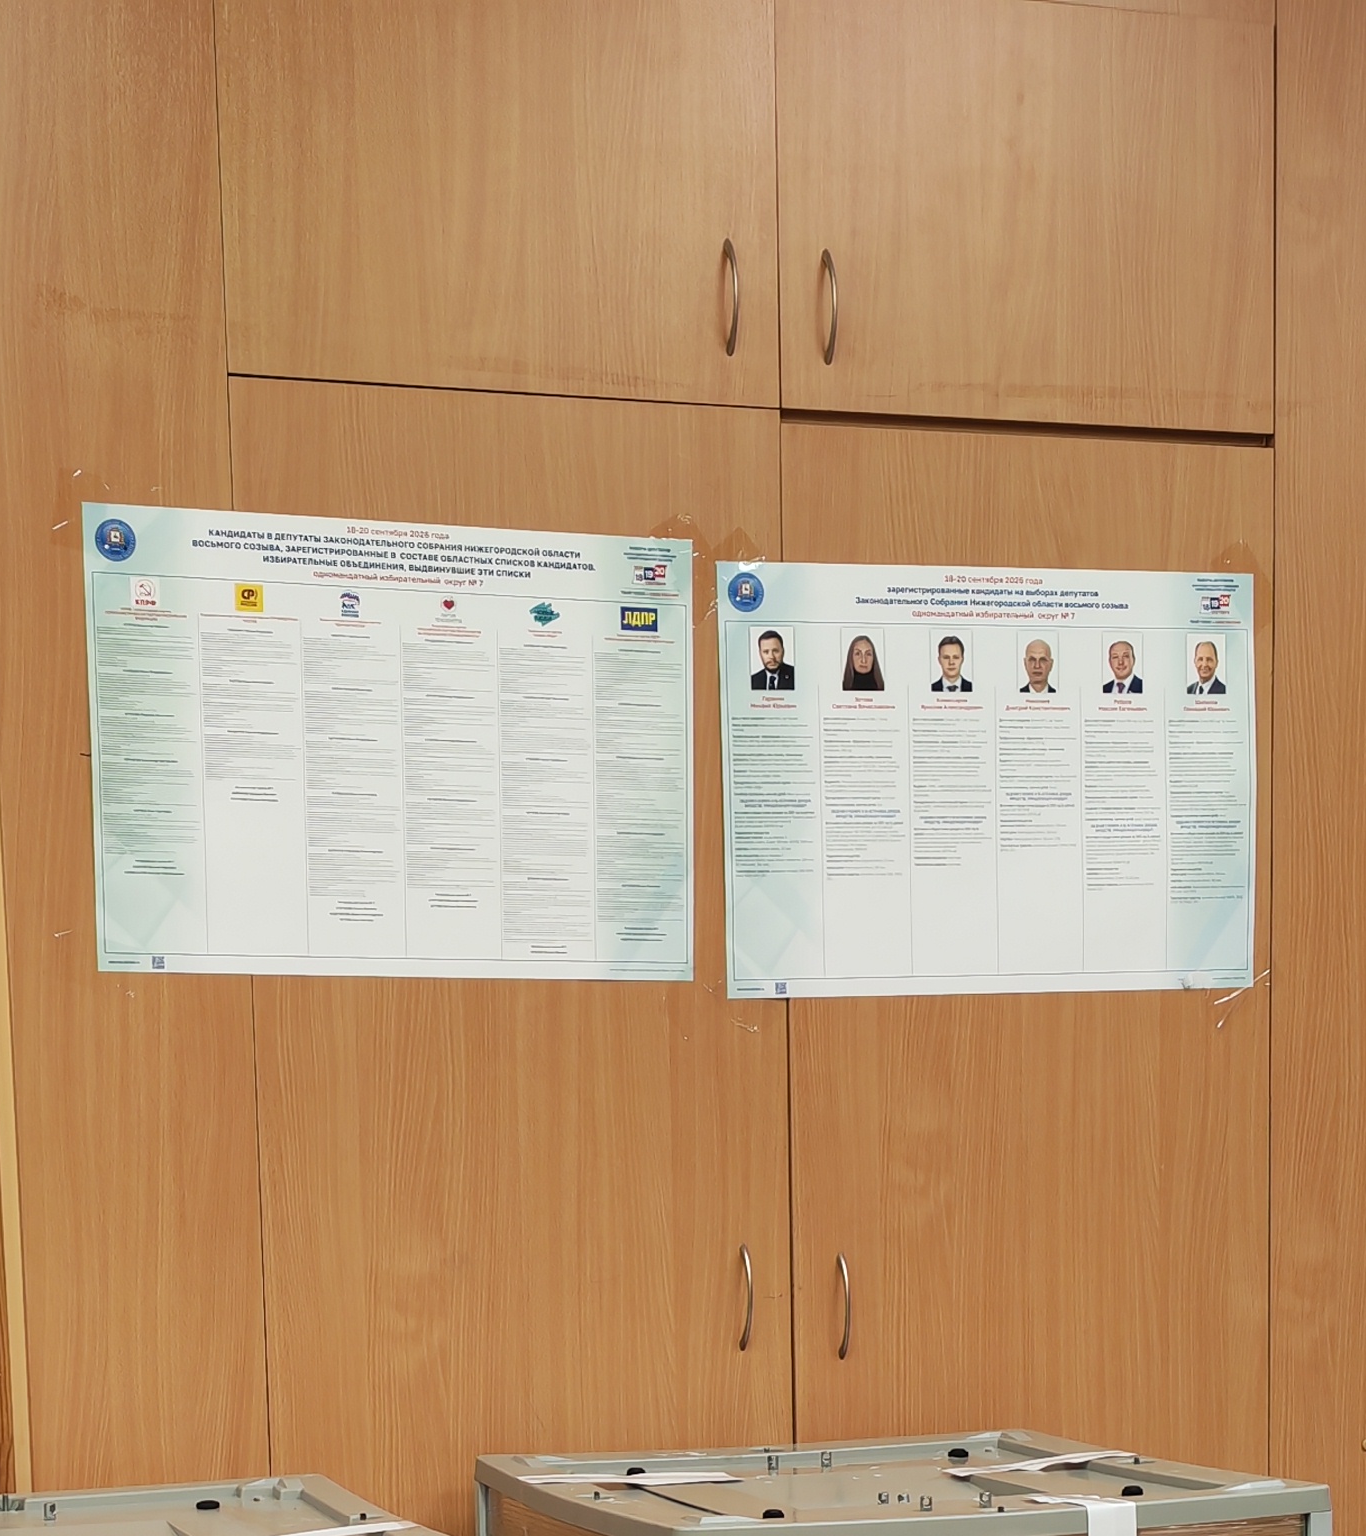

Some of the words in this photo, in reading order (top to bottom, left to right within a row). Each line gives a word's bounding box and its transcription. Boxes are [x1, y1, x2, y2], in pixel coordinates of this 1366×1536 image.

[208, 529, 265, 540] КАНДИДАТЫ
[267, 532, 273, 540] В
[274, 533, 321, 543] ДЕПУТАТЫ
[323, 536, 415, 549] ЗАКОНОДАТЕЛЬНОГО
[417, 542, 463, 552] СОБРАНИЯ
[464, 544, 540, 557] НИЖЕГОРОДСКОЙ
[542, 550, 581, 559] ОБЛАСТИ
[192, 540, 242, 550] ВОСЬМОГО
[243, 543, 284, 553] СОЗЫВА,
[285, 545, 388, 559] ЗАРЕГИСТРИРОВАННЫЕ
[400, 552, 439, 562] СОСТАВЕ
[440, 555, 493, 565] ОБЛАСТНЫХ
[495, 558, 536, 568] СПИСКОВ
[537, 561, 596, 571] КАНДИДАТОВ.
[262, 555, 338, 568] ИЗБИРАТЕЛЬНЫЕ
[340, 559, 407, 572] ОБЪЕДИНЕНИЯ,
[408, 564, 476, 576] ВЫДВИНУВШИЕ
[477, 569, 495, 577] ЭТИ
[496, 570, 531, 579] СПИСКИ
[887, 586, 970, 595] зарегистрированные
[971, 588, 1013, 597] кандидаты
[1025, 588, 1058, 598] выборах
[1059, 590, 1099, 598] депутатов
[855, 596, 929, 606] Законодательного
[930, 598, 968, 608] Собрания
[969, 600, 1031, 609] Нижегородской
[1032, 600, 1063, 608] области
[622, 611, 656, 627] ЛДПР
